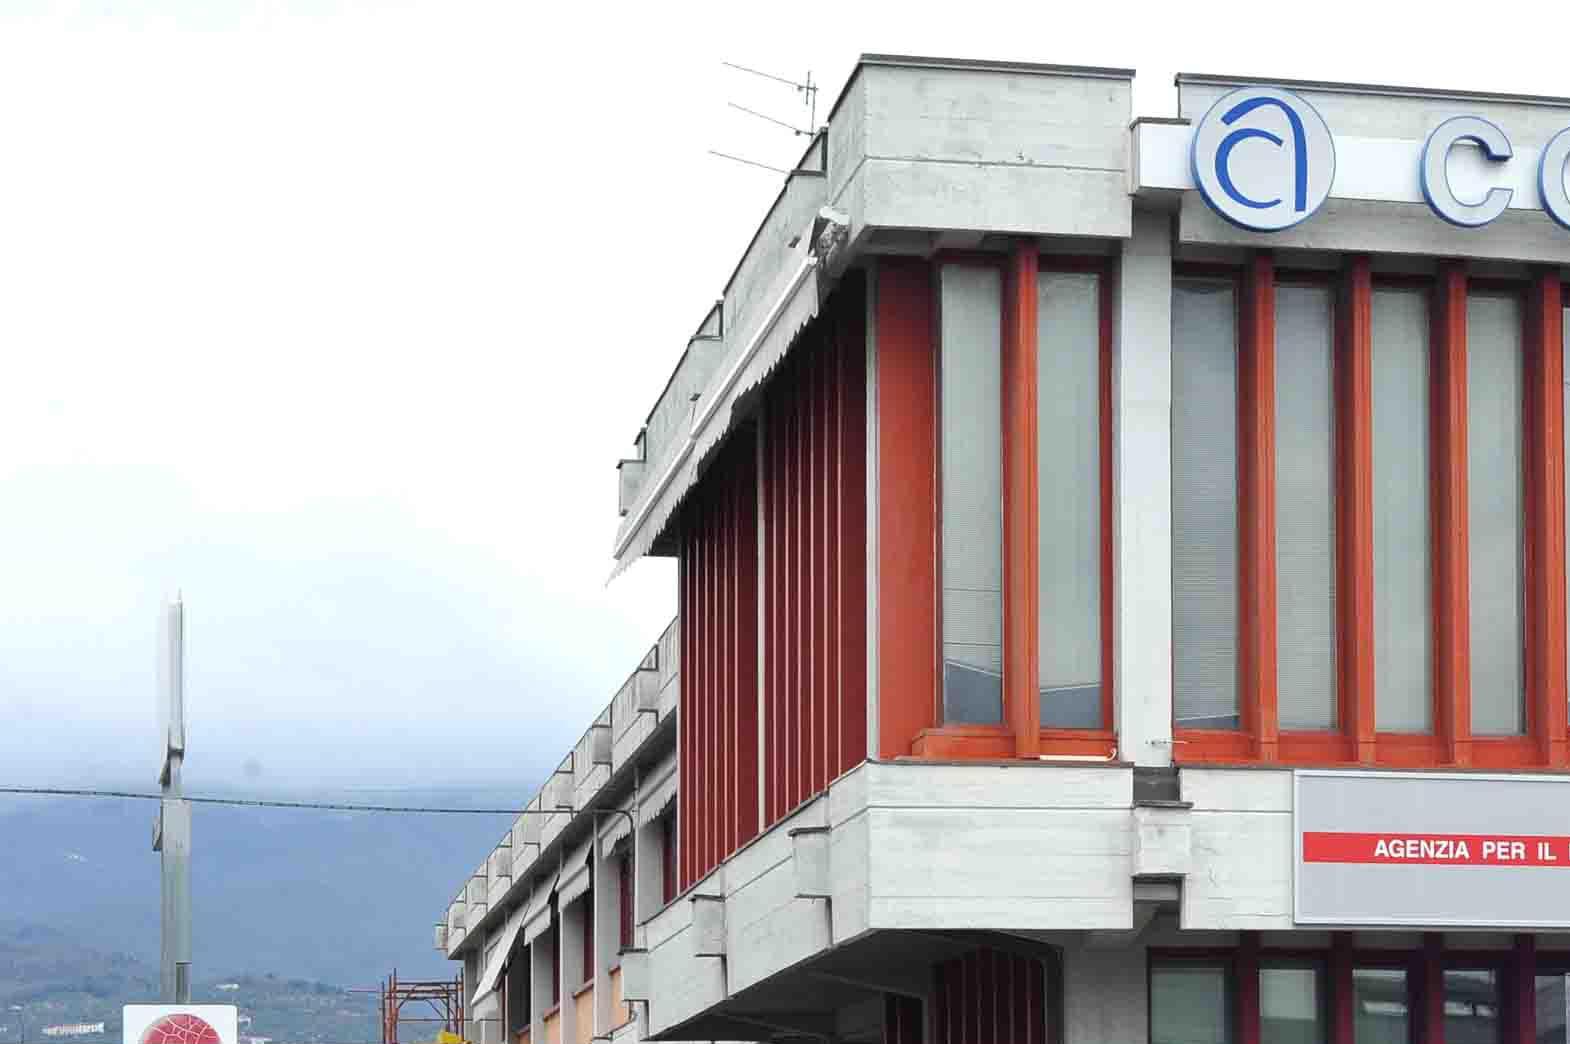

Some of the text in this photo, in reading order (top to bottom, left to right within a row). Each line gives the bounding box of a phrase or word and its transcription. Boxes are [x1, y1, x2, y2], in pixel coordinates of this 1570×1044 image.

[1374, 839, 1470, 859] AGENZIA
[1482, 841, 1526, 860] PER
[1537, 842, 1557, 861] IL
